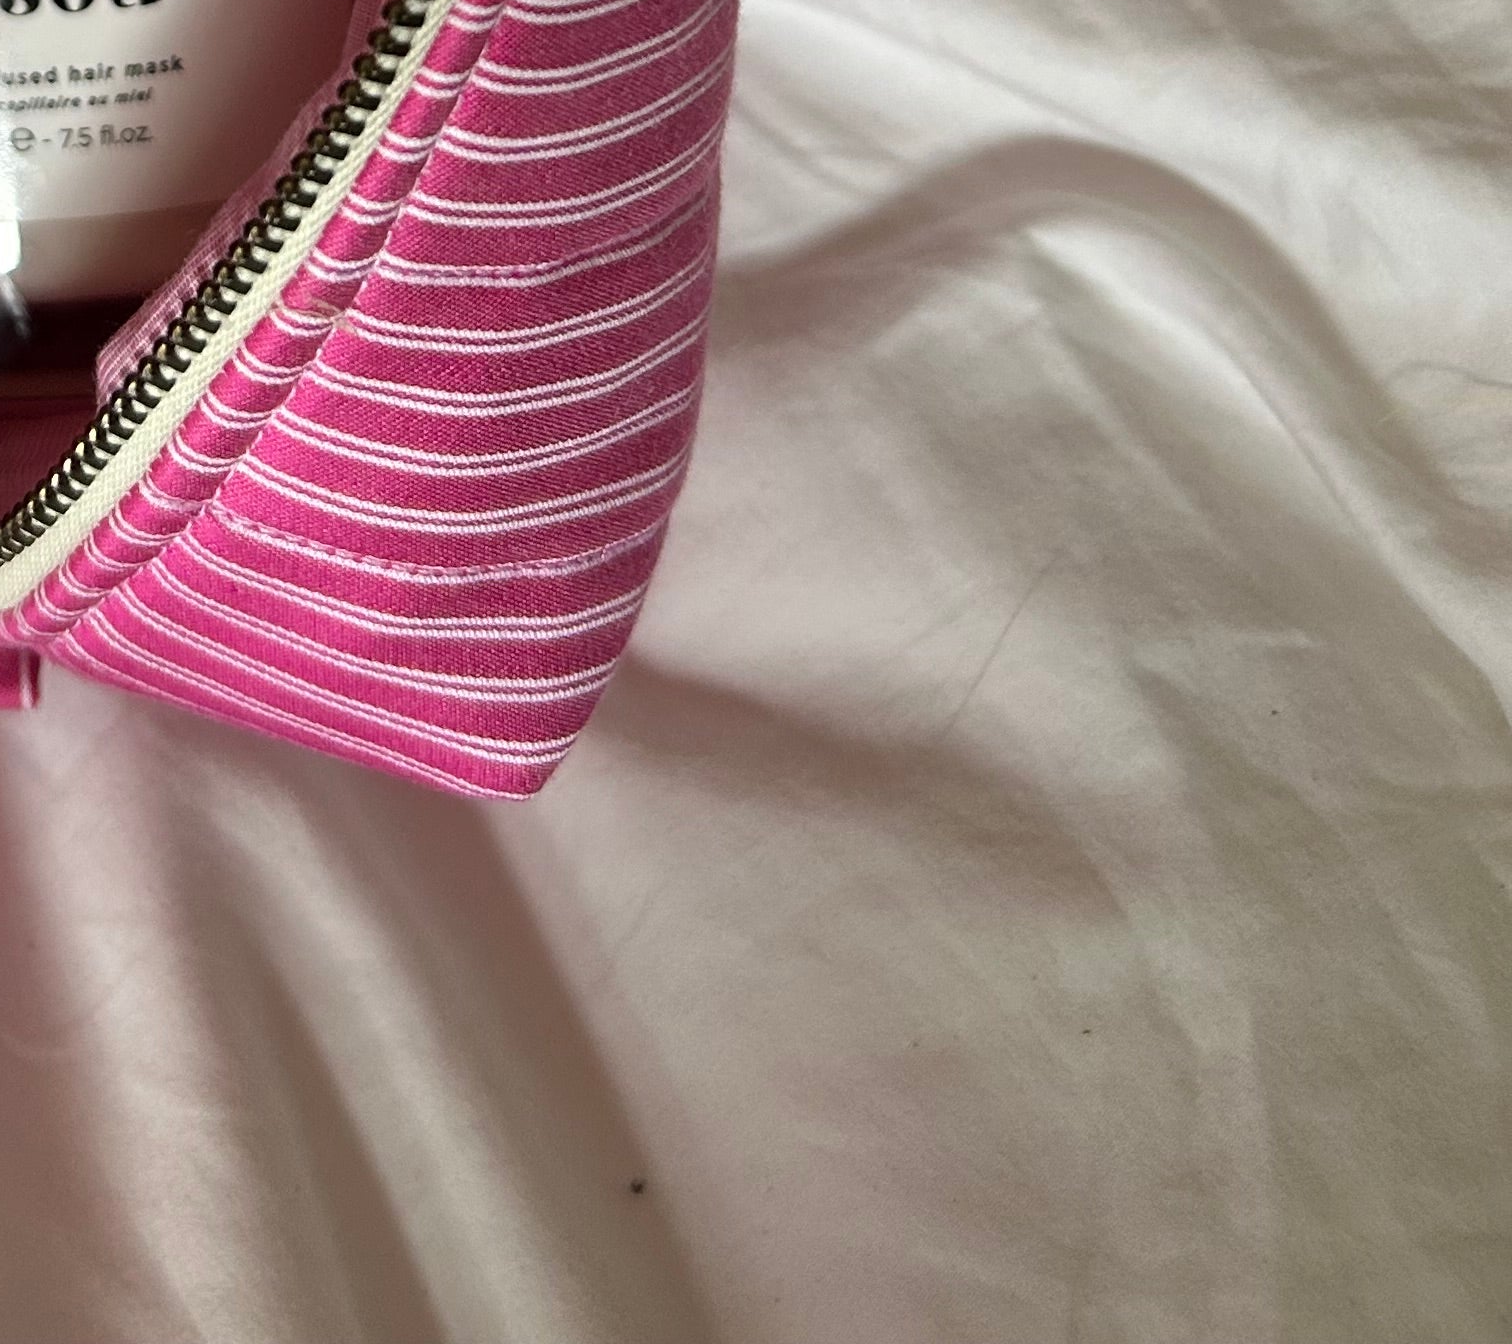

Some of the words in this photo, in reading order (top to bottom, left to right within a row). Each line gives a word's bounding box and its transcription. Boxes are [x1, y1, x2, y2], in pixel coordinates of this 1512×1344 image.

[68, 62, 115, 83] hair
[125, 54, 184, 76] mask
[114, 86, 154, 104] miel
